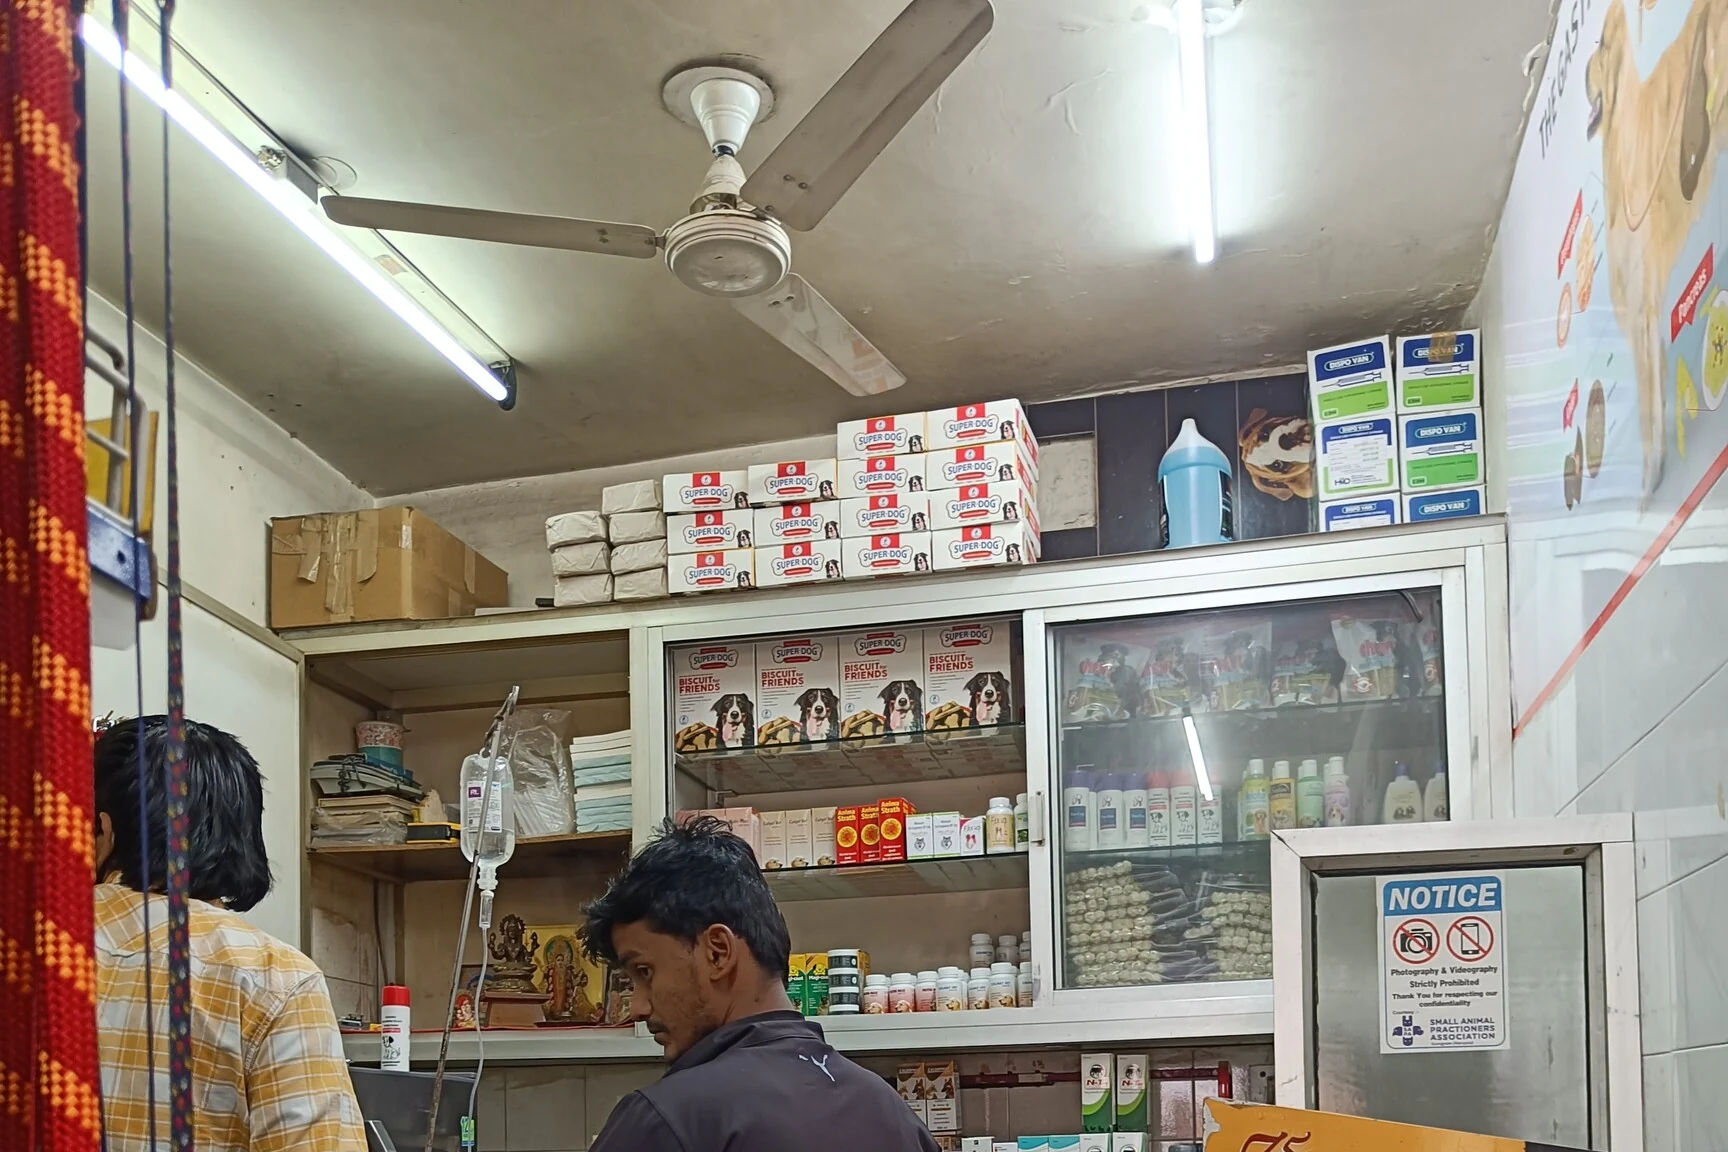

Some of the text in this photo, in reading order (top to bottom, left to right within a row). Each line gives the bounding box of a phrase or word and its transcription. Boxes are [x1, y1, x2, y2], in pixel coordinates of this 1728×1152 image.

[1328, 354, 1370, 370] DISPO VAN
[1419, 424, 1461, 438] DISPO VAN
[1423, 500, 1466, 515] DISPO VAN
[929, 654, 966, 664] BISCUIT
[844, 662, 880, 673] BISCUIT
[929, 661, 974, 672] FRIENDS
[761, 670, 796, 680] BISCUIT
[844, 669, 888, 681] FRIENDS
[679, 676, 713, 686] BISCUIT
[761, 677, 805, 688] FRIENDS
[679, 683, 721, 694] FRIENDS
[880, 800, 900, 808] Anima
[880, 806, 900, 814] Strath
[1388, 883, 1498, 911] NOTICE
[1390, 968, 1440, 977] Photography
[1449, 965, 1498, 974] Videography
[1409, 978, 1480, 989] Strictly Prohibited
[1444, 990, 1484, 999] respecting
[1418, 1000, 1471, 1008] confidentiality
[1430, 1018, 1459, 1026] SMALL
[1430, 1025, 1496, 1033] PRACTIONERS
[1430, 1032, 1496, 1041] ASSOCIATION
